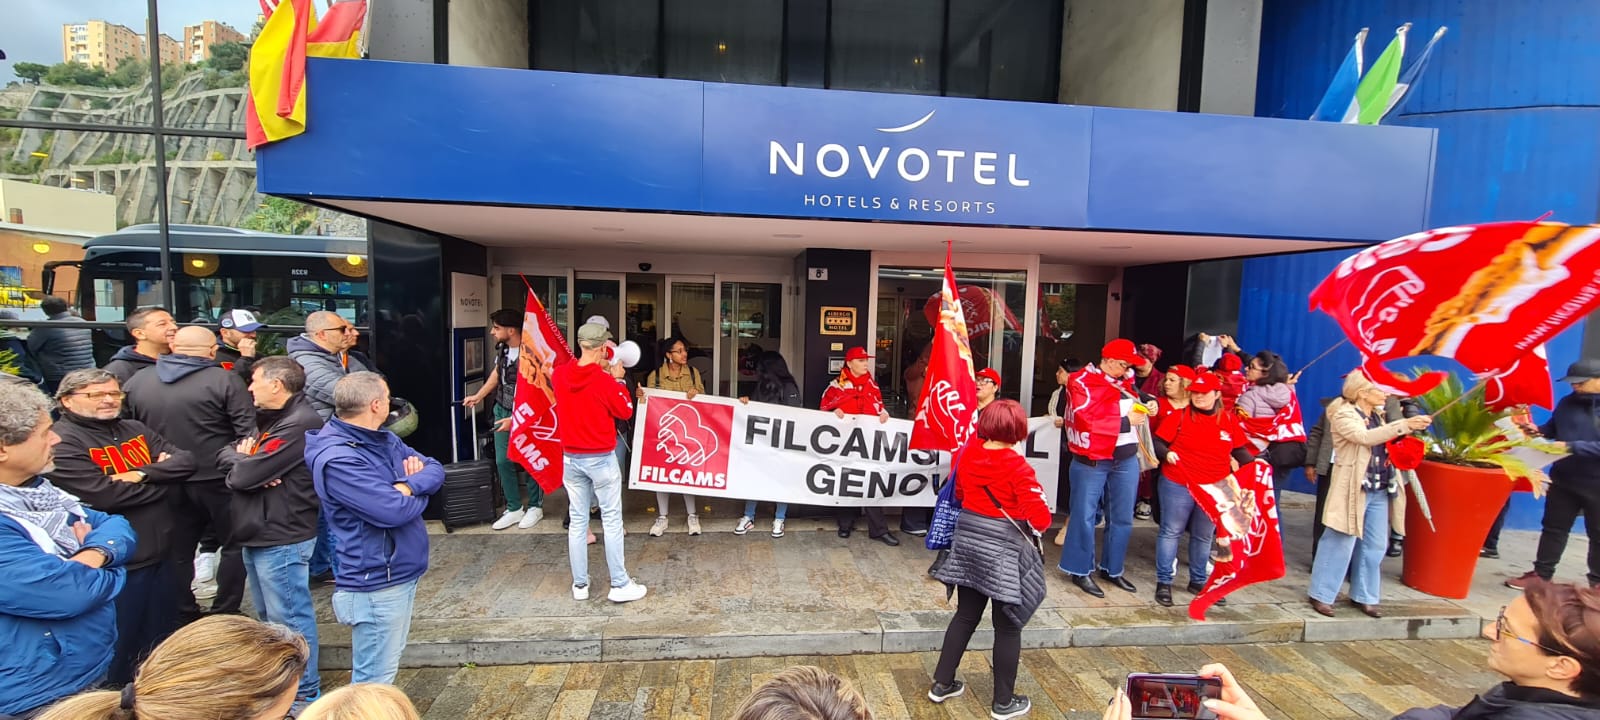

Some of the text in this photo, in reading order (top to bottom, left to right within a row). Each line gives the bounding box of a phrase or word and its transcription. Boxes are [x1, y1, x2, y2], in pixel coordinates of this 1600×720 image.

[769, 140, 1030, 187] NOVOTEL
[804, 194, 995, 214] HOTELS & RESORTS
[640, 465, 725, 488] FILCAMS
[805, 463, 949, 498] GENOV
